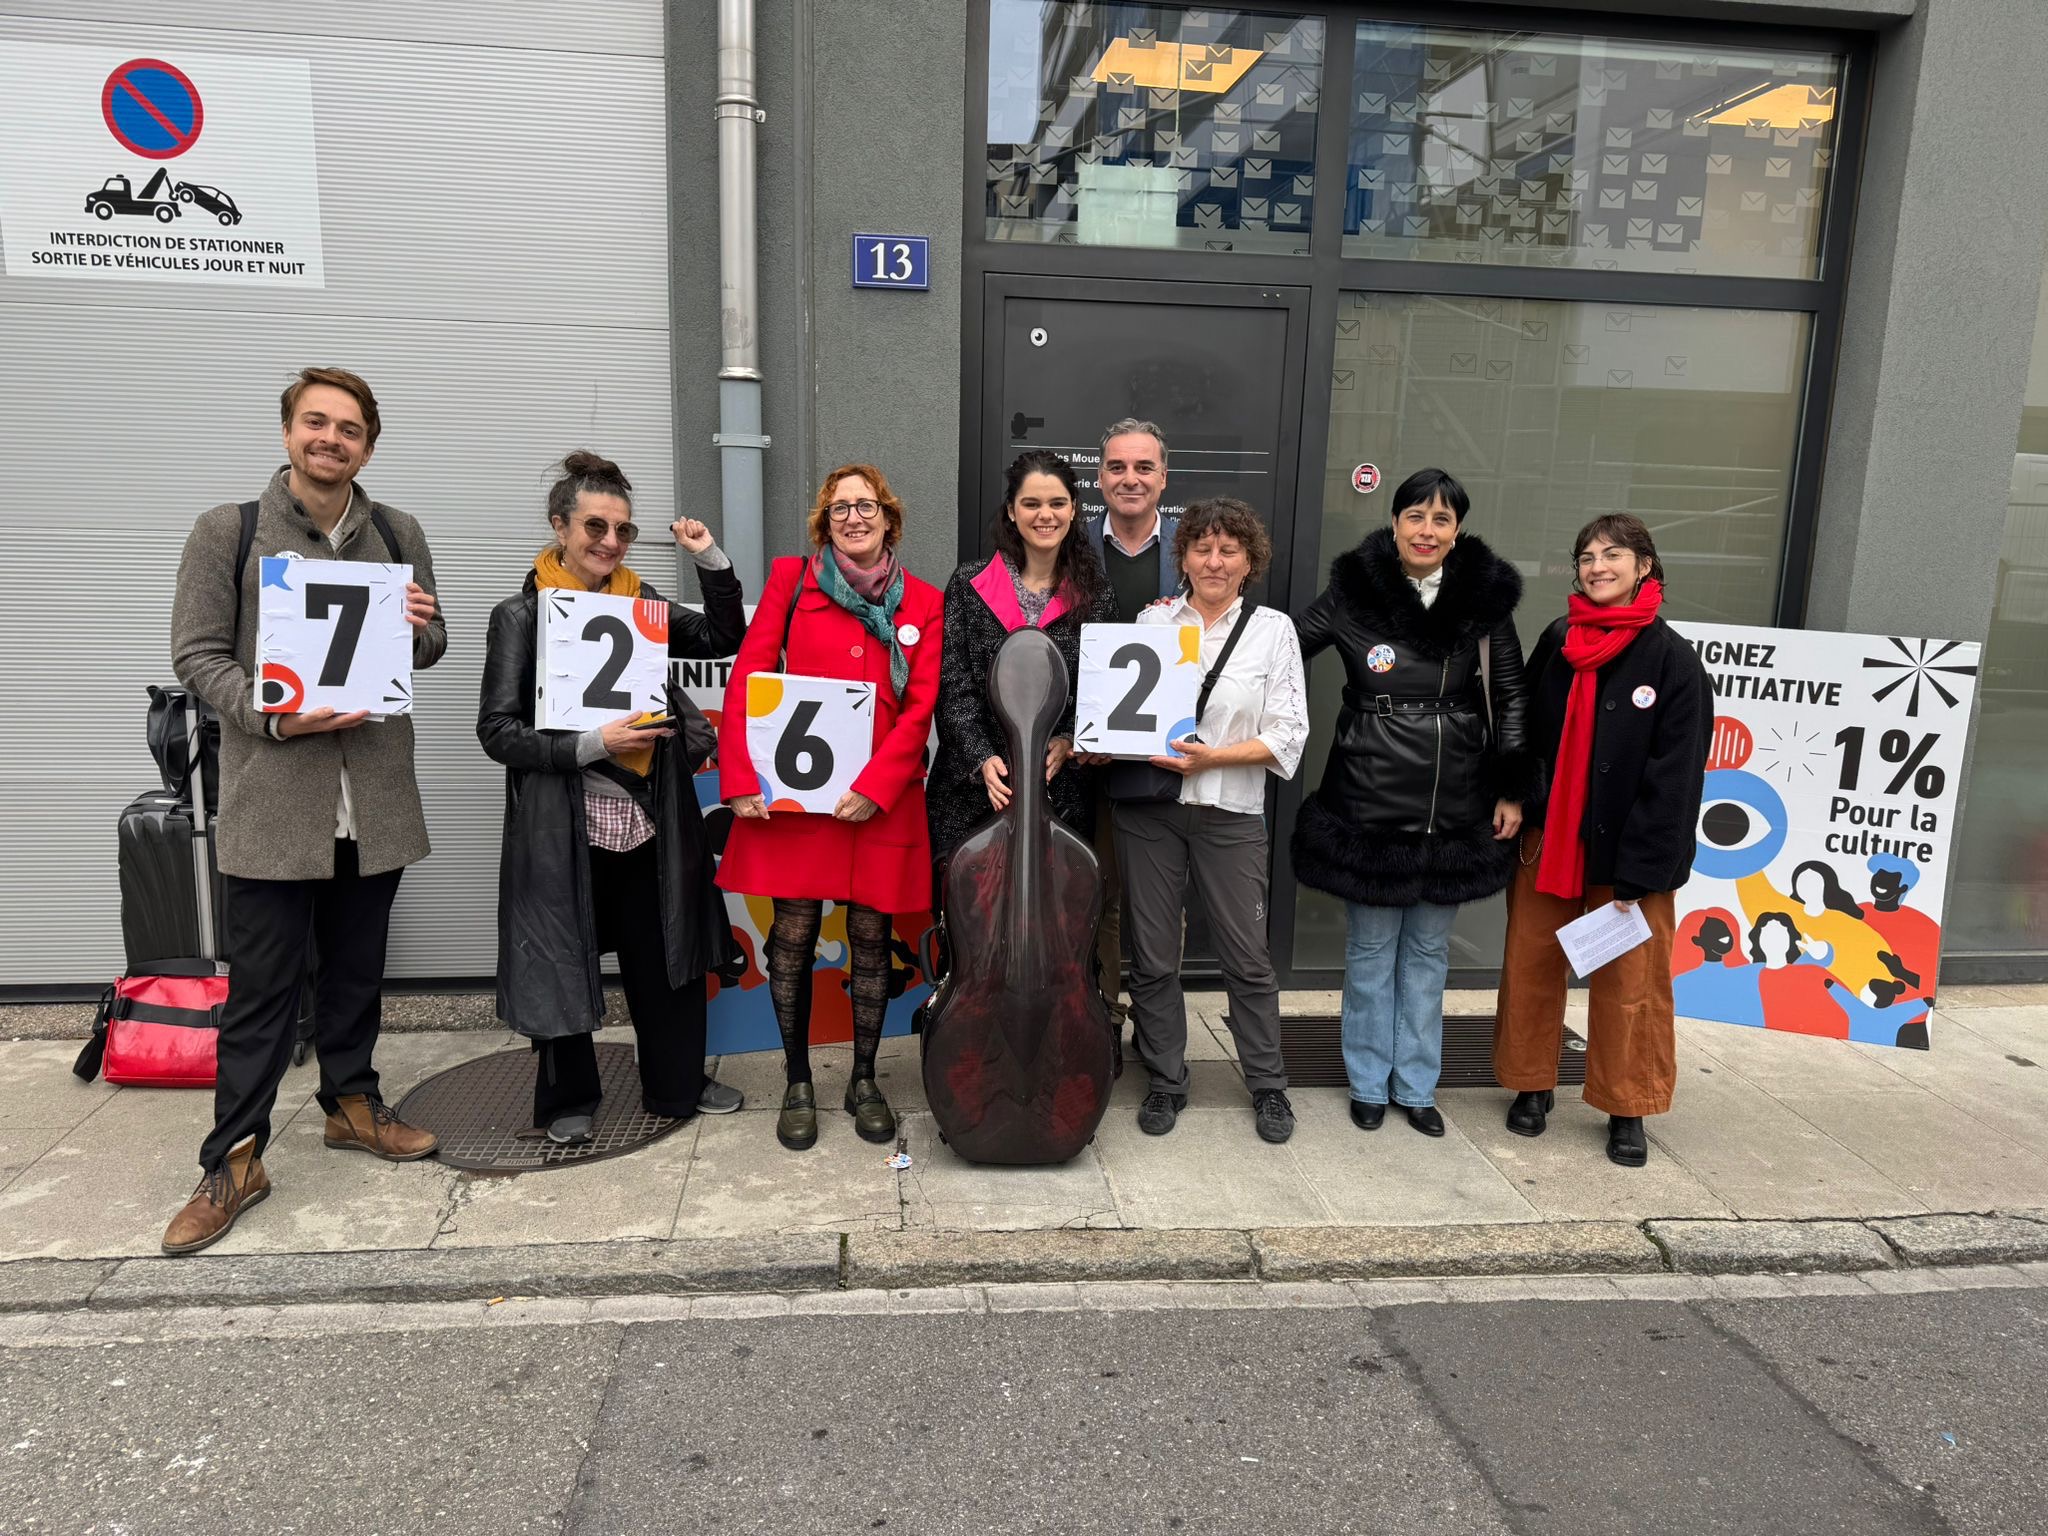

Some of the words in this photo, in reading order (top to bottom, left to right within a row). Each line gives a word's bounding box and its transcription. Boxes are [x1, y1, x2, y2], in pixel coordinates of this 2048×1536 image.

[50, 232, 160, 249] INTERDICTION
[165, 237, 186, 250] DE
[189, 238, 285, 254] STATIONNER
[31, 251, 87, 266] SORTIE
[91, 253, 112, 267] DE
[114, 253, 200, 271] VÉHICULES
[203, 259, 244, 273] JOUR
[247, 260, 265, 273] ET
[269, 261, 305, 275] NUIT
[870, 242, 912, 280] 13
[1072, 453, 1100, 463] Moue
[1074, 478, 1091, 488] rie
[1082, 503, 1106, 513] Supp
[1158, 505, 1187, 514] ératio
[305, 583, 370, 686] 7
[581, 614, 634, 711] 2
[672, 661, 732, 688] INIT
[1107, 642, 1162, 732] 2
[1708, 673, 1842, 706] NITIATIVE
[774, 700, 835, 791] 6
[1829, 796, 1902, 828] Pour
[1911, 804, 1938, 832] la
[1825, 830, 1933, 863] culture
